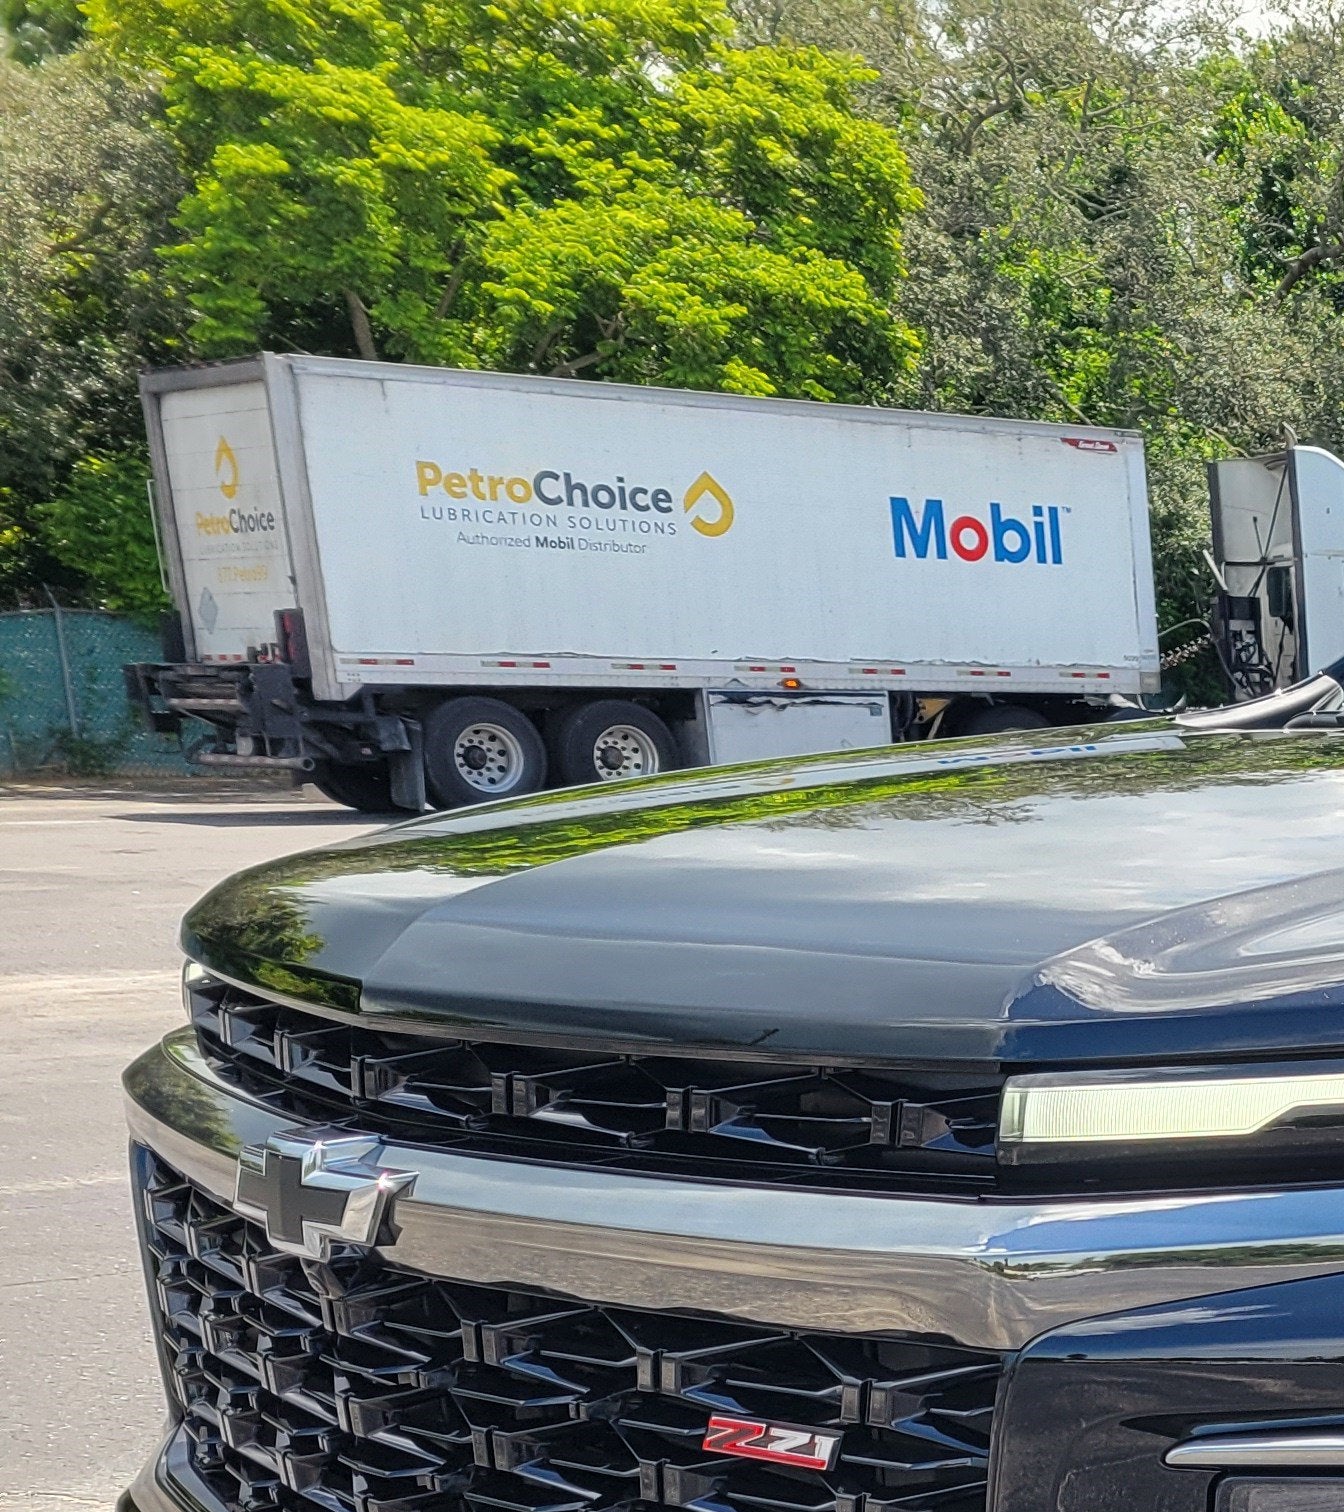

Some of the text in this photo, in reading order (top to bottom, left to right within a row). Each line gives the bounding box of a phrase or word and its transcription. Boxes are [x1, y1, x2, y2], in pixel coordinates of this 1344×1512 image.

[415, 460, 673, 514] PetroChoice
[195, 506, 275, 536] PetroChoice
[420, 506, 677, 535] LUBRICATION SOLUTIONS
[889, 496, 1063, 565] Mobil
[456, 531, 647, 554] Authorized Mobil Distributor
[702, 1416, 842, 1471] Z71
